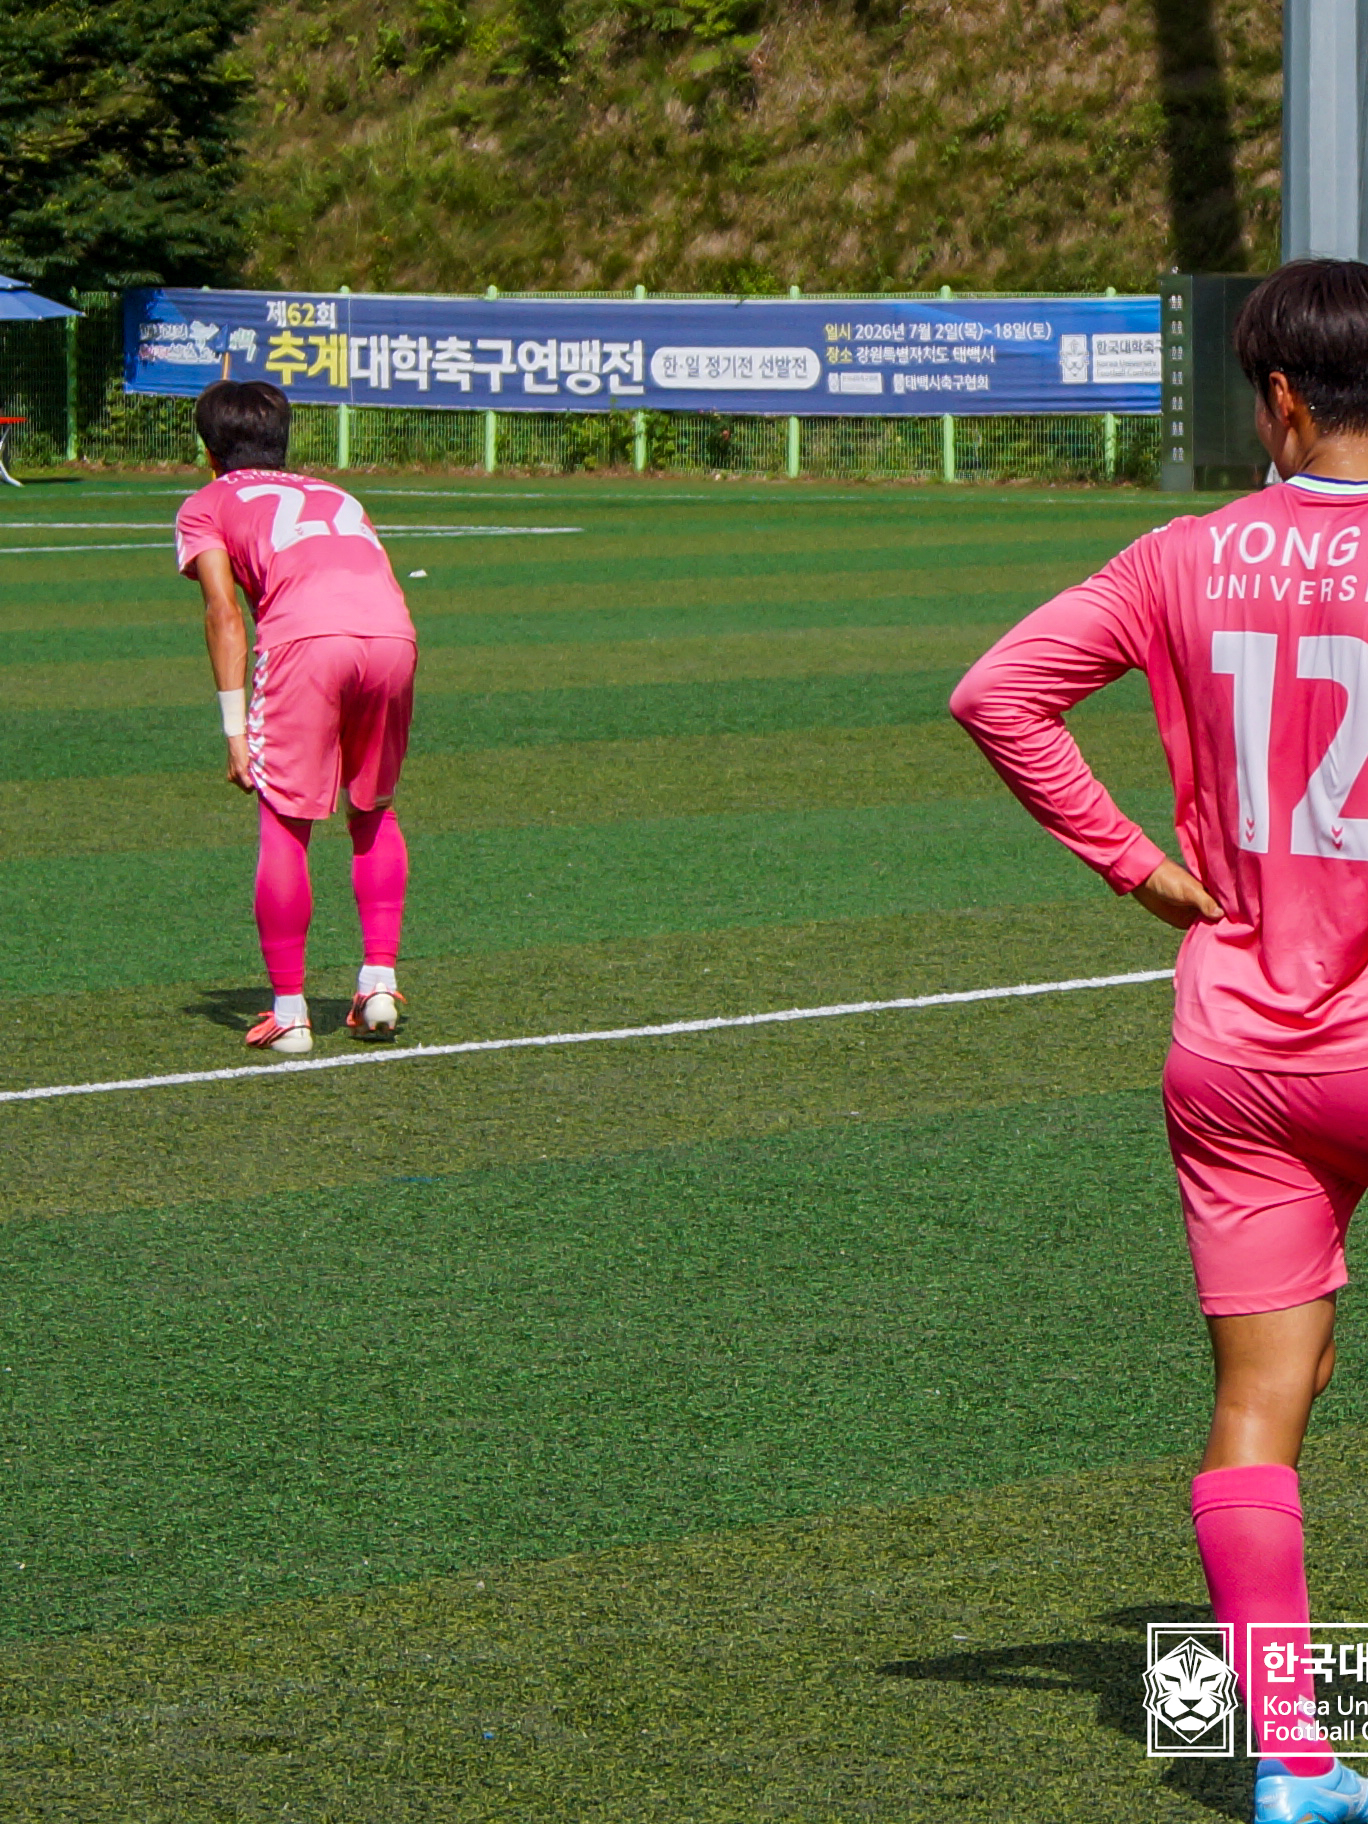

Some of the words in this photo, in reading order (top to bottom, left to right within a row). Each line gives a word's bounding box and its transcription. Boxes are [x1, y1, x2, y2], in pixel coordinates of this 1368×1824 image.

[266, 300, 336, 329] 제62회
[825, 322, 851, 341] 일시
[855, 322, 905, 341] 2026년
[909, 322, 932, 341] 7월
[705, 354, 754, 379] 정기전
[758, 354, 809, 379] 선발전
[826, 345, 853, 364] 장소
[856, 345, 949, 364] 강원특별자치도
[952, 345, 996, 364] 태백시
[235, 483, 384, 553] 22
[1208, 520, 1361, 571] YONG
